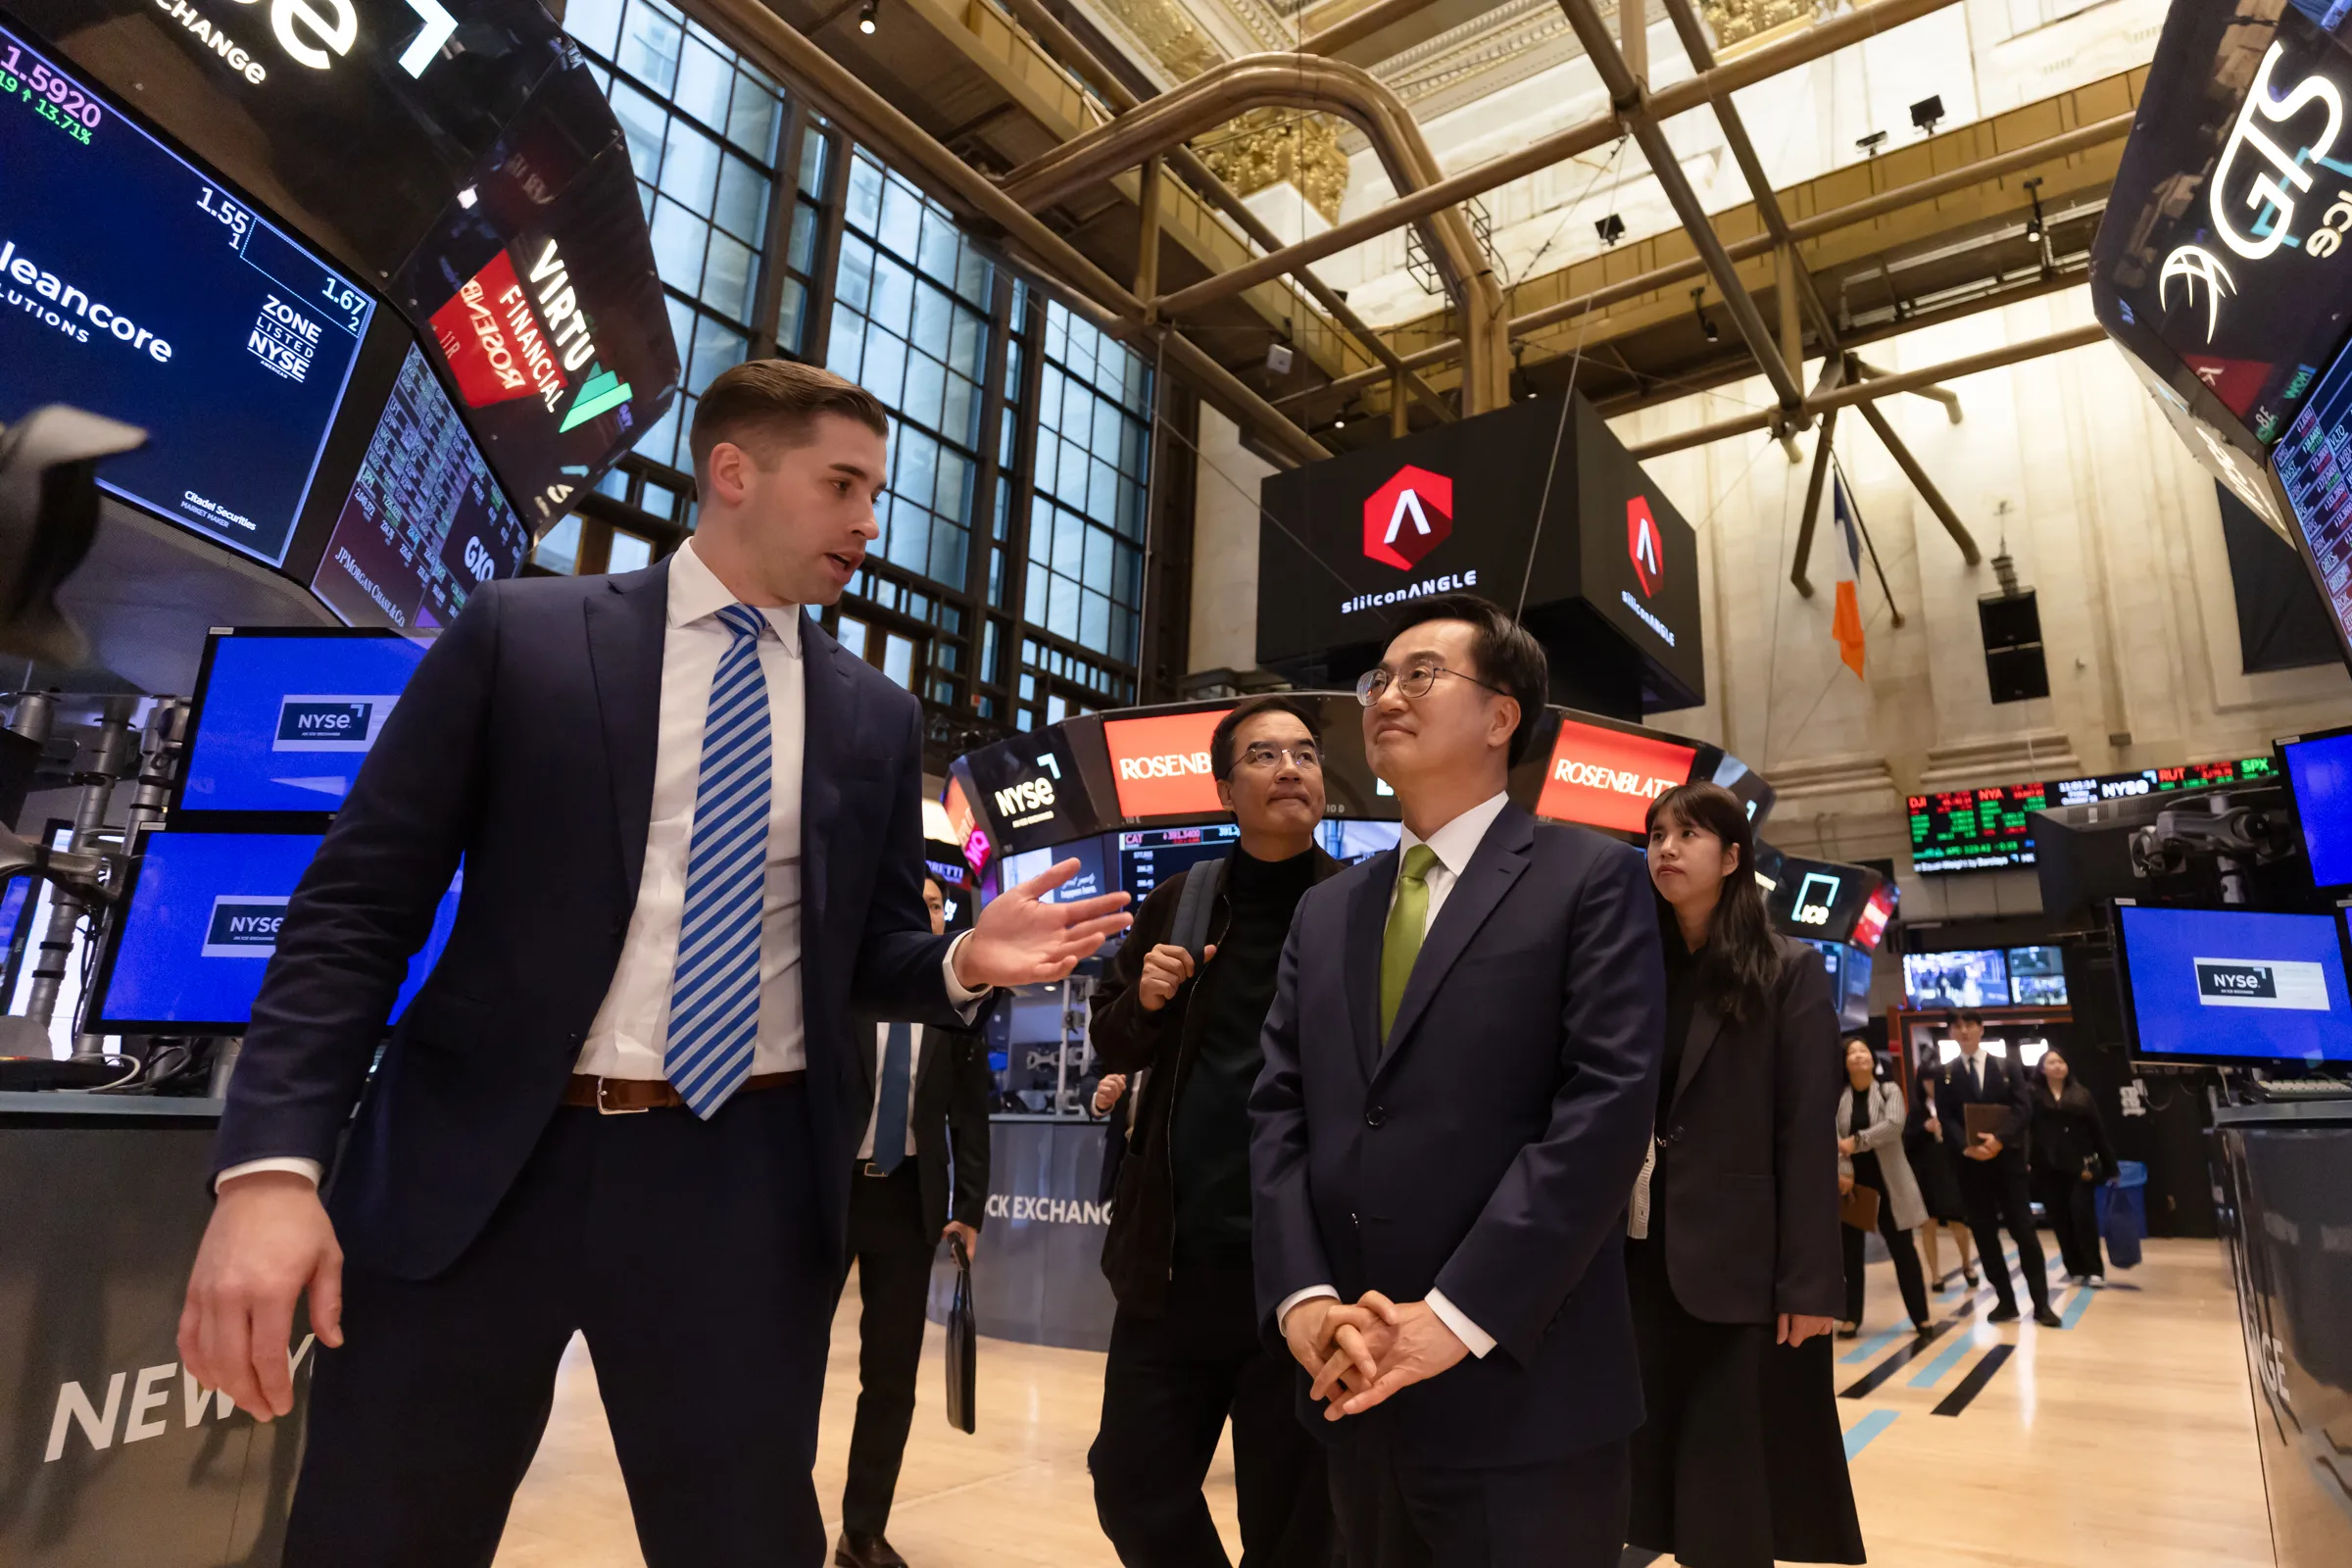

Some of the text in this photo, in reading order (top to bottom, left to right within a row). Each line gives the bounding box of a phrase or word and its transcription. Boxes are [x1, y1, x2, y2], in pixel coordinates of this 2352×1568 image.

[1, 46, 101, 127] 1.5920
[35, 99, 93, 145] 13.71%
[196, 186, 249, 234] 1.55
[0, 283, 90, 343] UTIONS
[321, 276, 367, 317] 1.67
[529, 239, 595, 371] VIRTU
[257, 316, 315, 359] LISTED
[263, 294, 322, 343] ZONE
[348, 317, 359, 332] 2
[248, 329, 310, 381] NYSE
[500, 284, 564, 413] FINANCIAL
[2329, 422, 2345, 448] VLTO
[180, 501, 229, 527] MARKET MAKER
[184, 490, 257, 530] Citadel Securities
[1978, 788, 2003, 801] NYA
[2158, 767, 2185, 781] RUT
[1908, 796, 1927, 808] DJI
[1125, 833, 1144, 844] CAT
